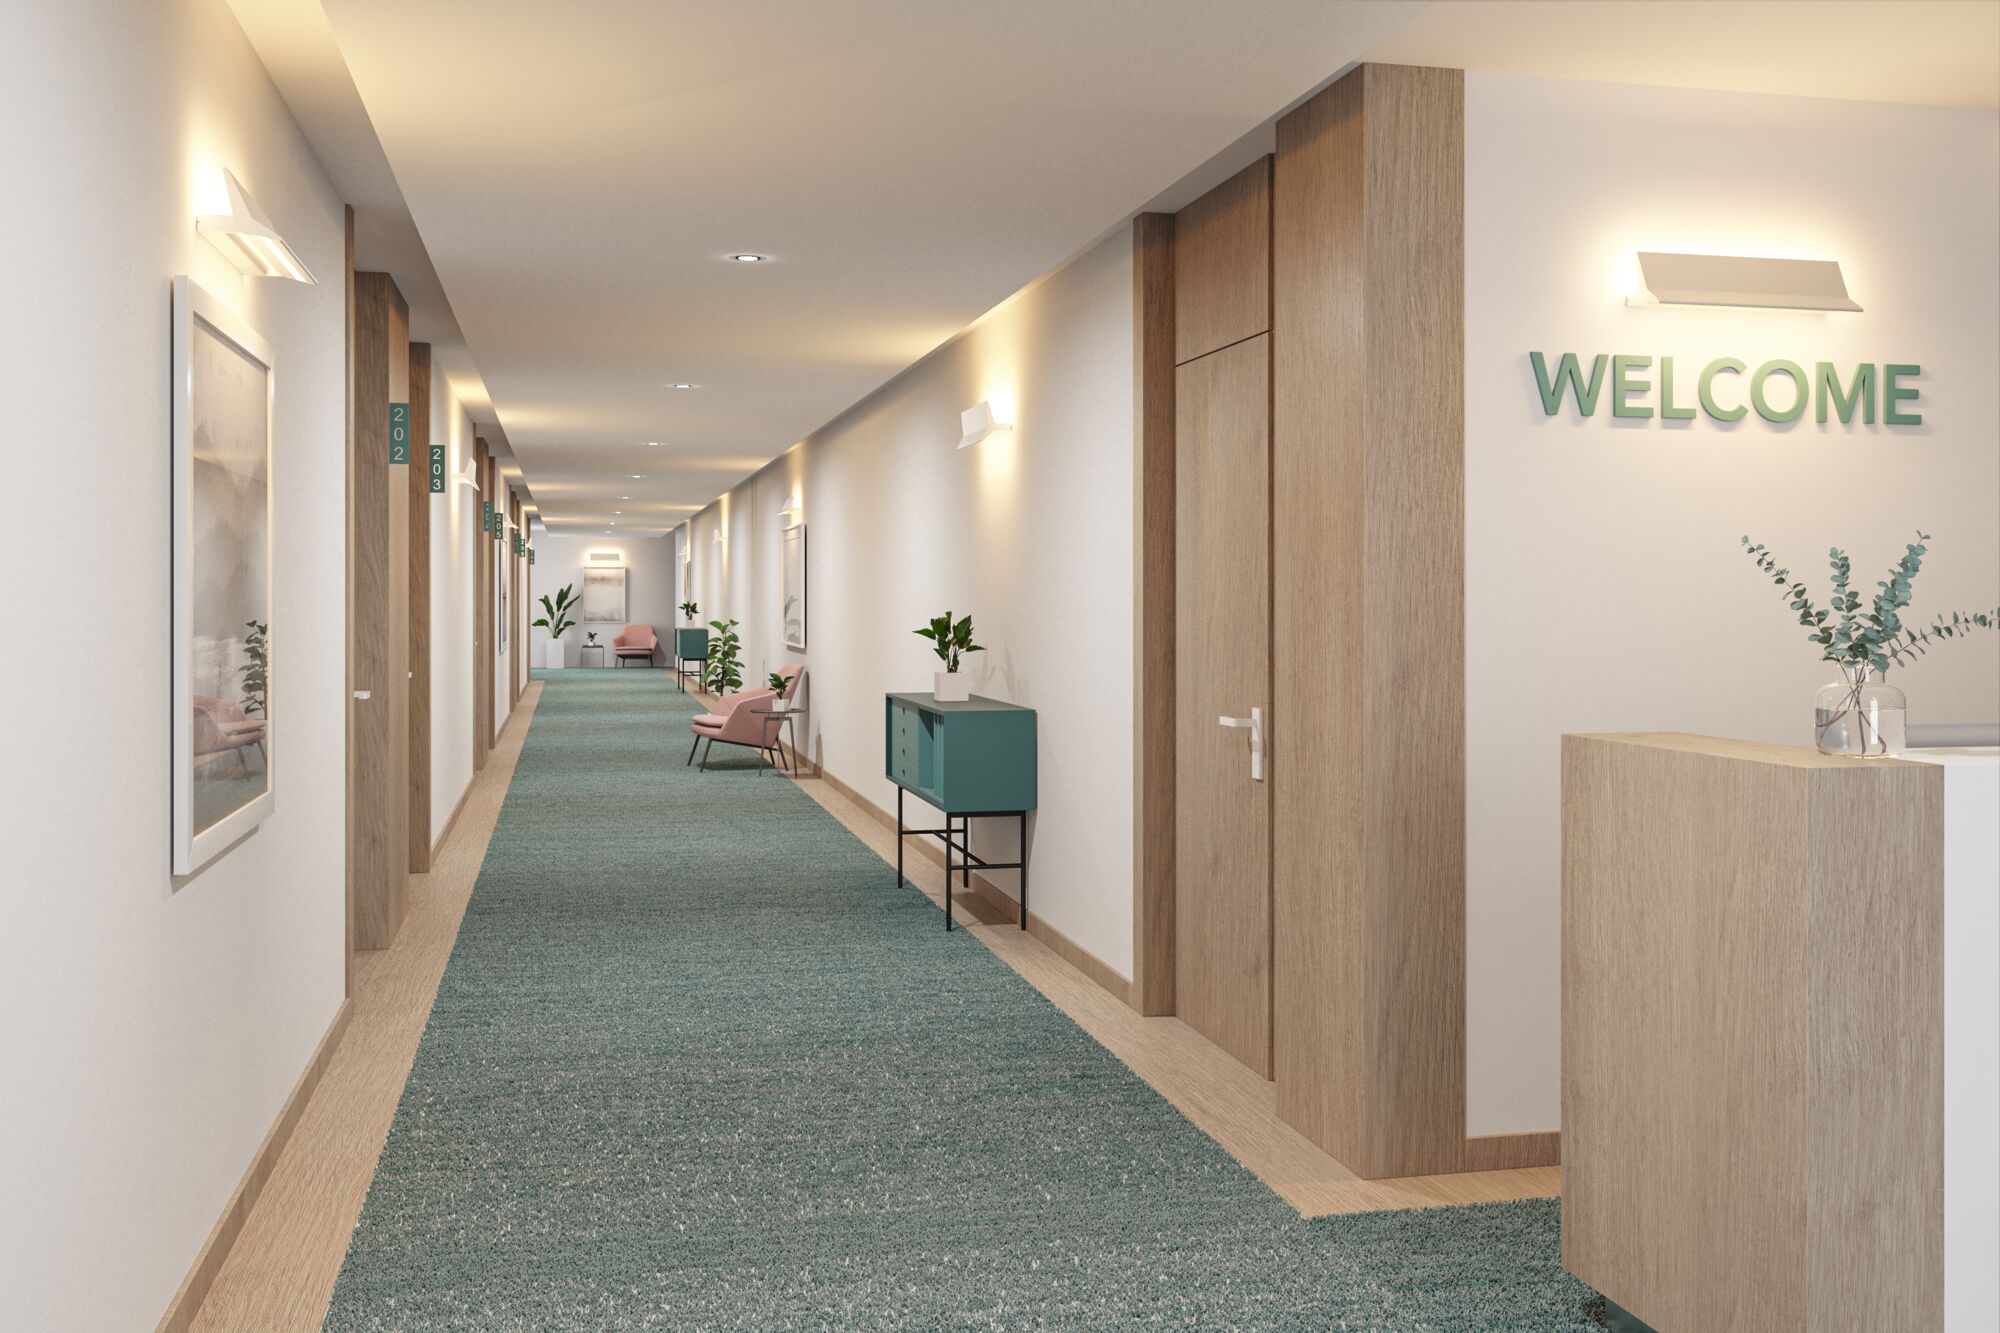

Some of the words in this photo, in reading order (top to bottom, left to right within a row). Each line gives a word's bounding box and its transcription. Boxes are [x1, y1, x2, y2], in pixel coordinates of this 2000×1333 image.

[1529, 351, 1922, 425] WELCOME
[394, 407, 404, 461] 202
[432, 448, 441, 490] 203
